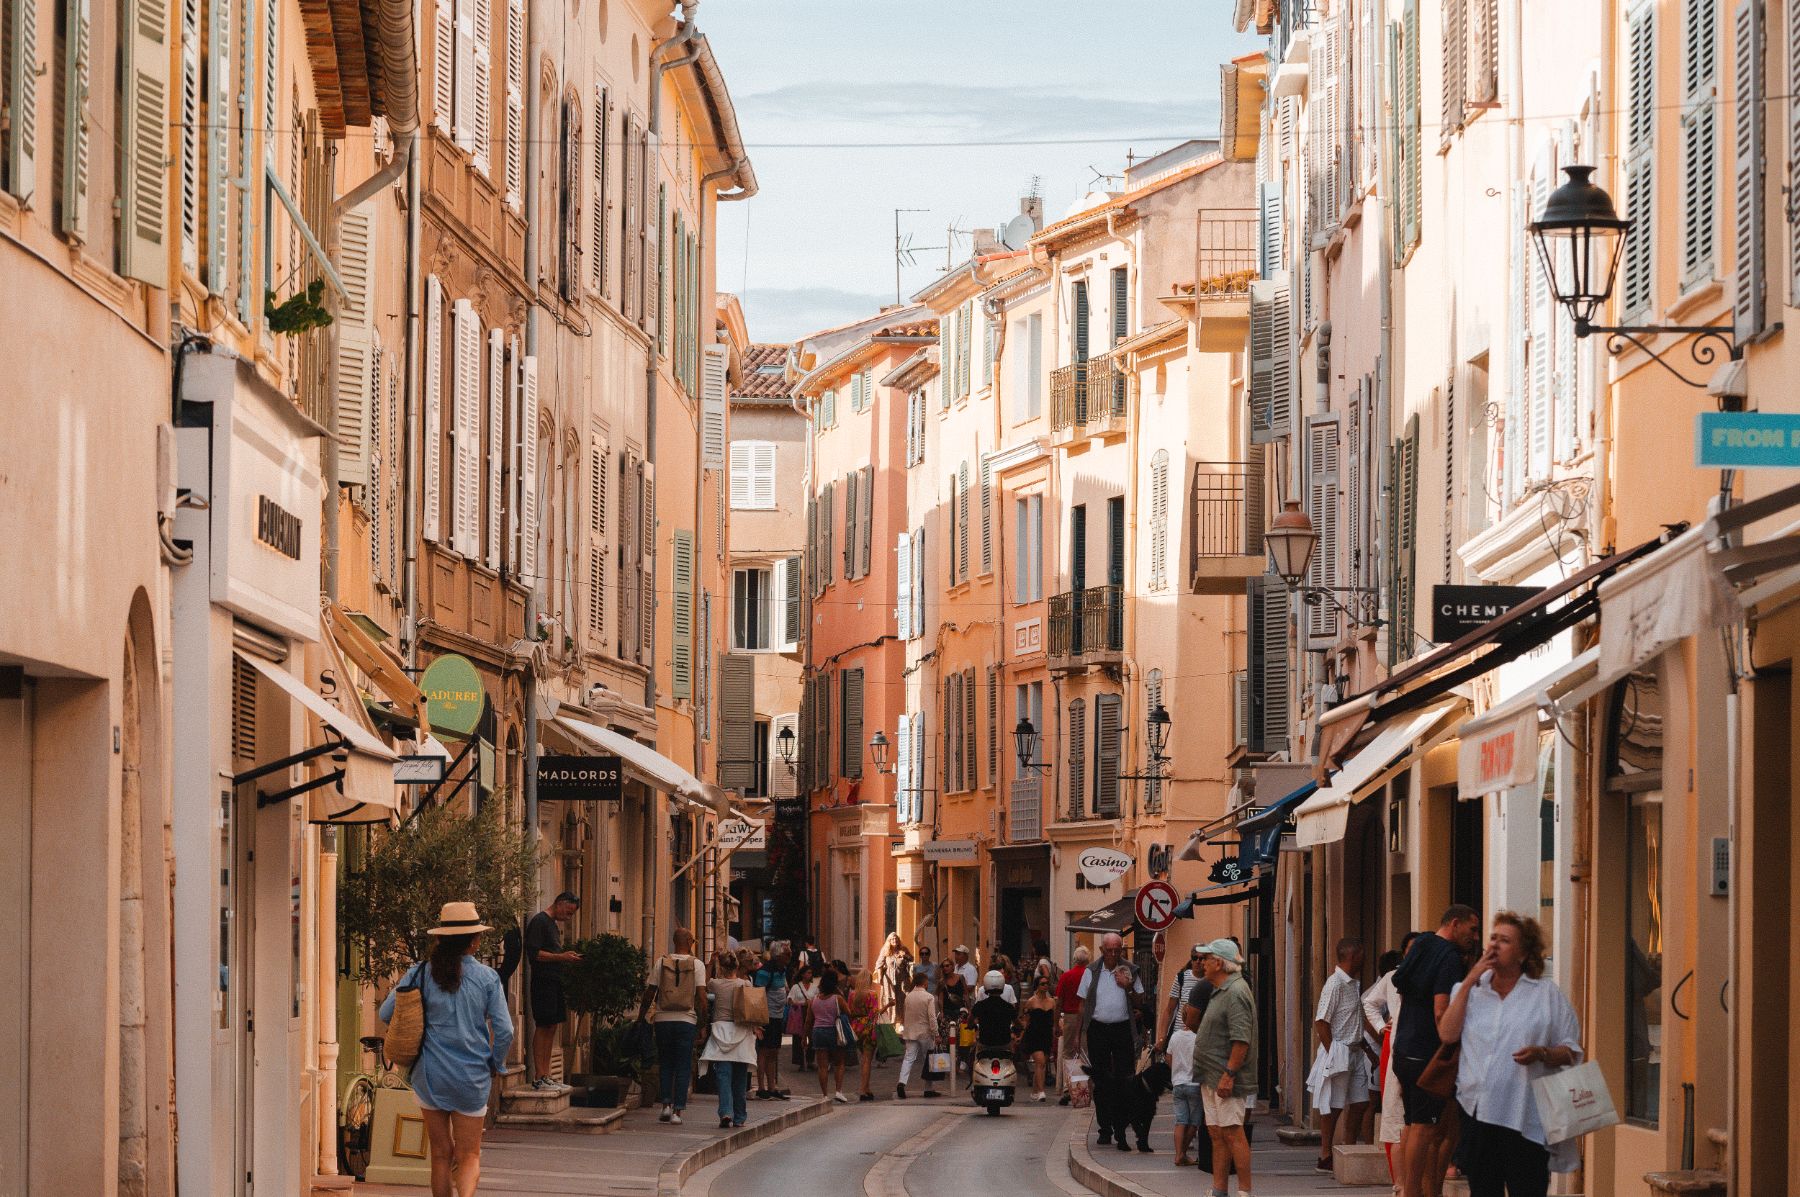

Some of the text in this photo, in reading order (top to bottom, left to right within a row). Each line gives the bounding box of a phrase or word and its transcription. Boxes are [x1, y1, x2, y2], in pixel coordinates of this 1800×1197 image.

[1711, 428, 1784, 448] FROM
[538, 769, 617, 780] MADLORDS
[1081, 855, 1128, 868] Casino
[1109, 866, 1125, 875] shop
